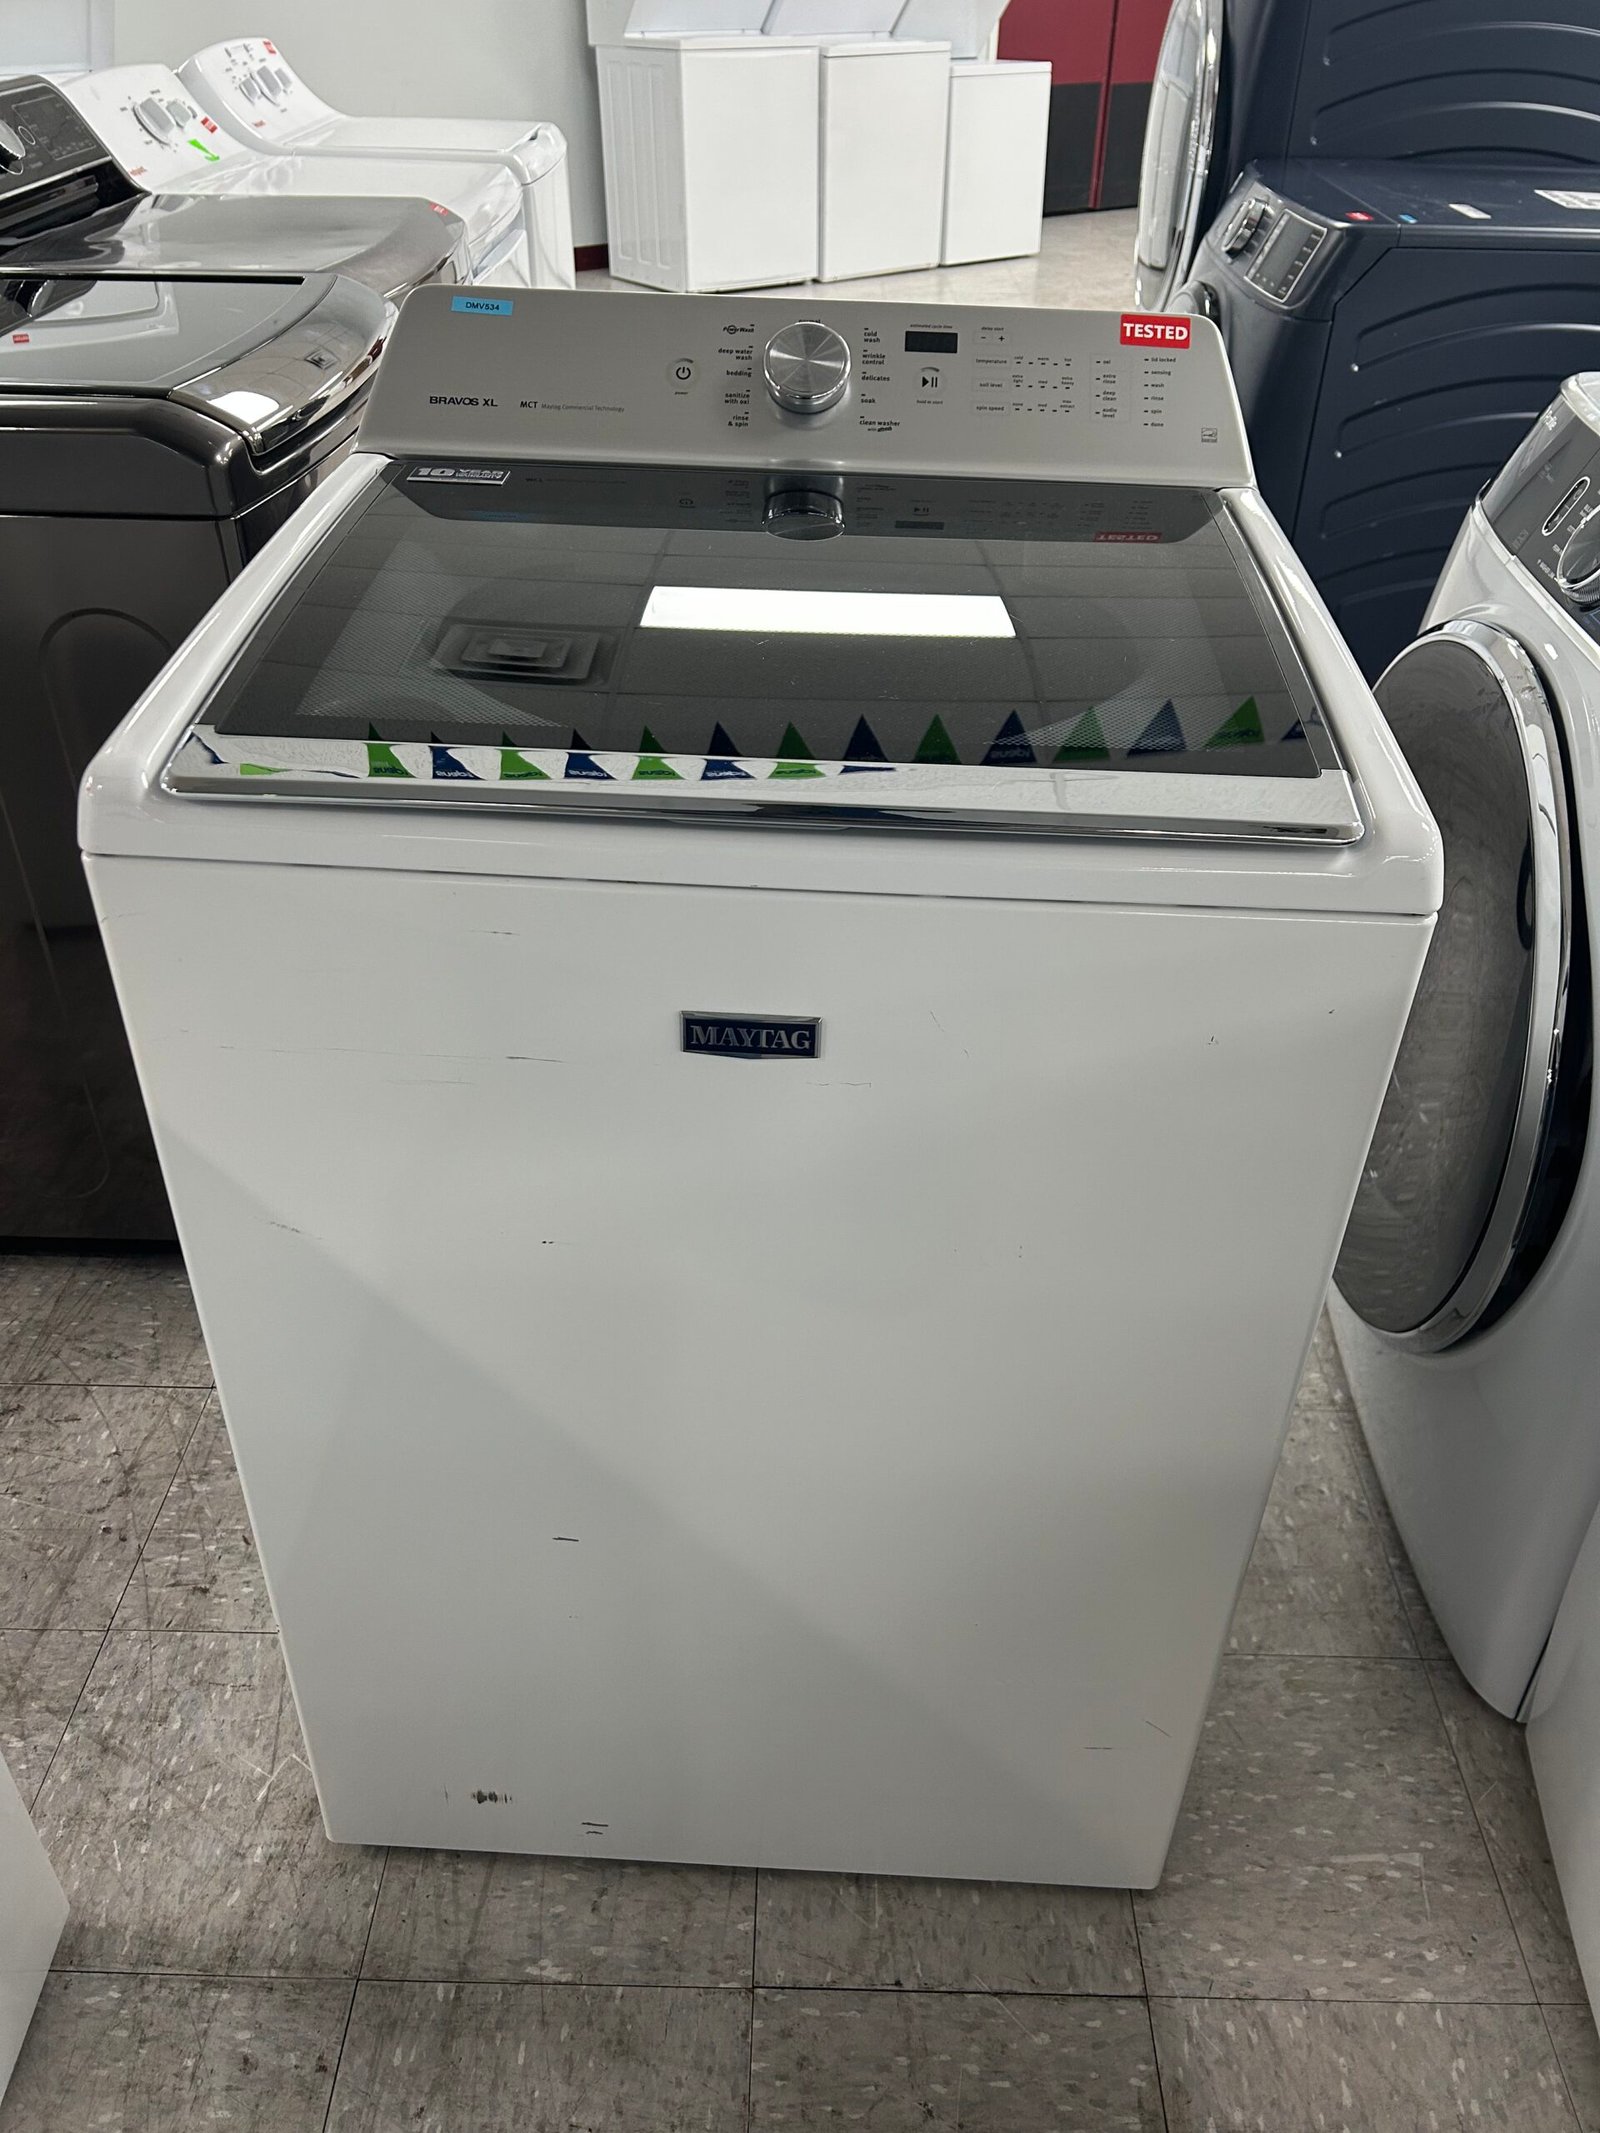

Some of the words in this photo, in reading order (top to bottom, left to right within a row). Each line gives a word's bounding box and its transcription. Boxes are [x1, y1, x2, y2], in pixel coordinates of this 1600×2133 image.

[465, 301, 500, 311] DMV534
[1123, 323, 1188, 340] TESTED
[429, 396, 480, 406] BRAVOS
[482, 398, 498, 407] XL
[520, 401, 538, 410] MCT
[418, 467, 456, 477] 10
[690, 1025, 812, 1050] MAYTAG
